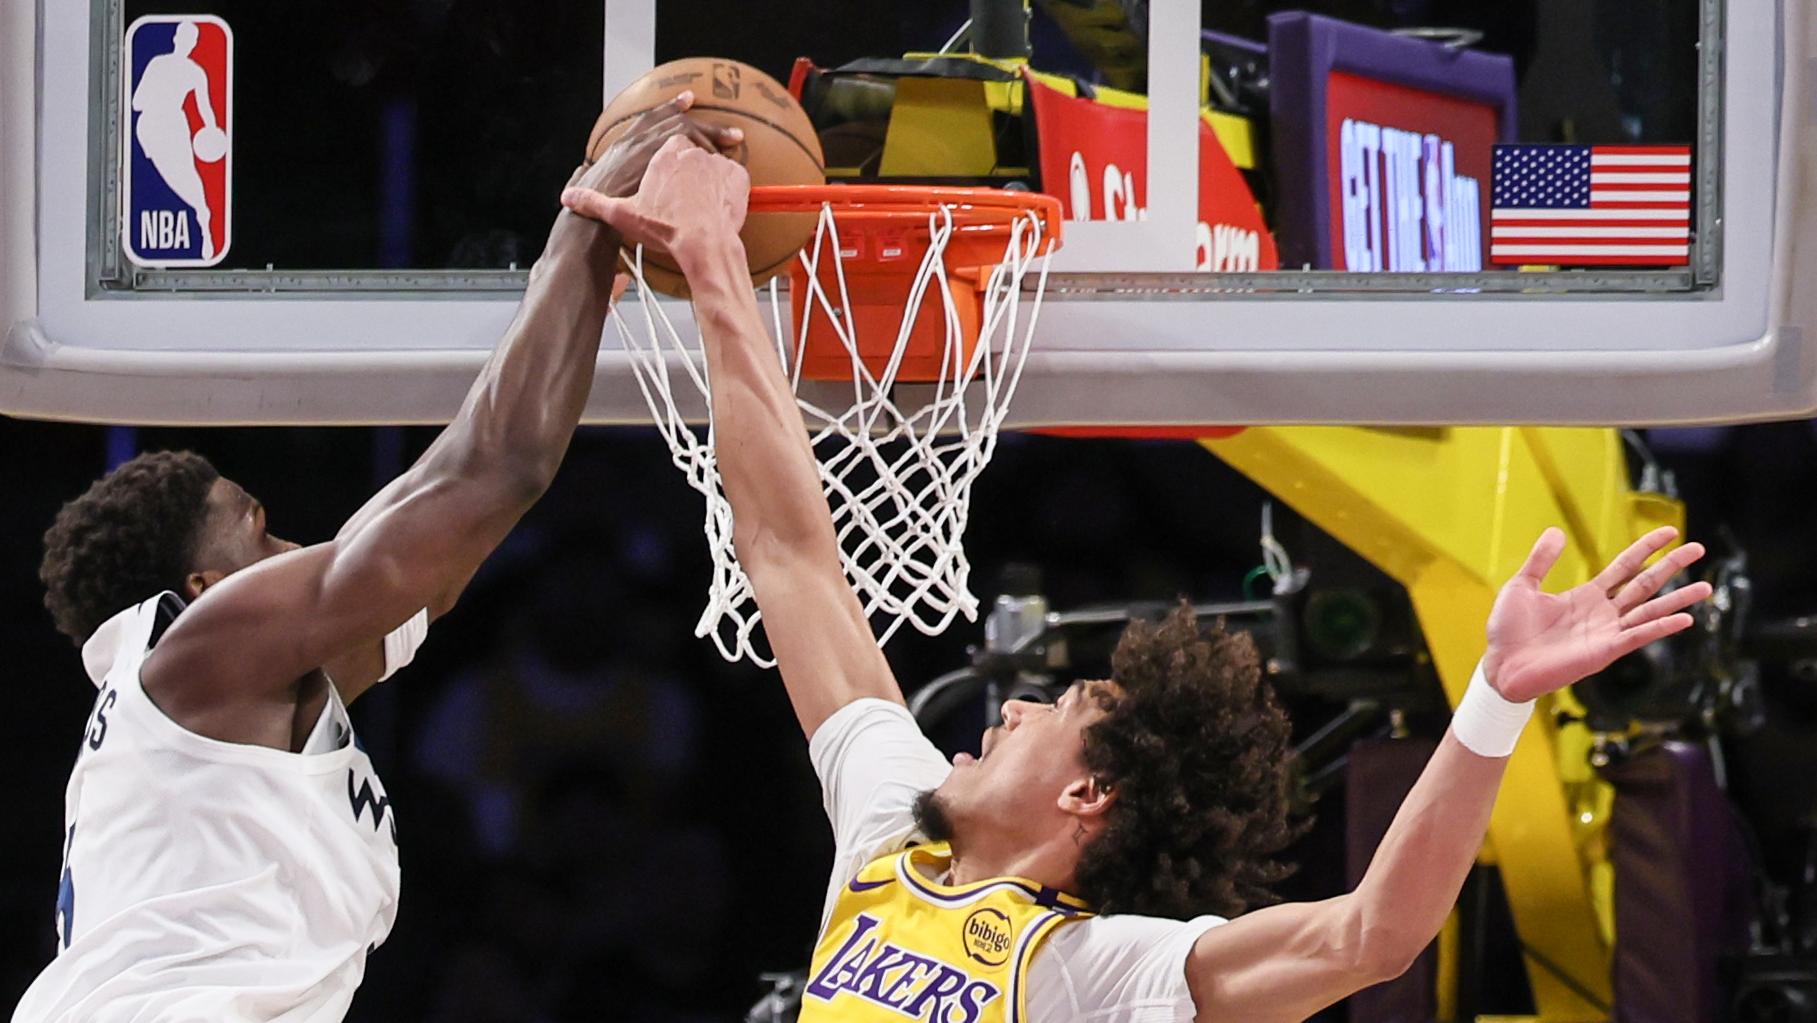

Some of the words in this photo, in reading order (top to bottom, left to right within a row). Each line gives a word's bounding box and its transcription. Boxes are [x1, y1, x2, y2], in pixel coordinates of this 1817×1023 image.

[141, 210, 190, 249] NBA
[1197, 222, 1260, 272] arm
[969, 918, 1010, 953] bibigo
[805, 912, 1000, 1023] LAKERS
